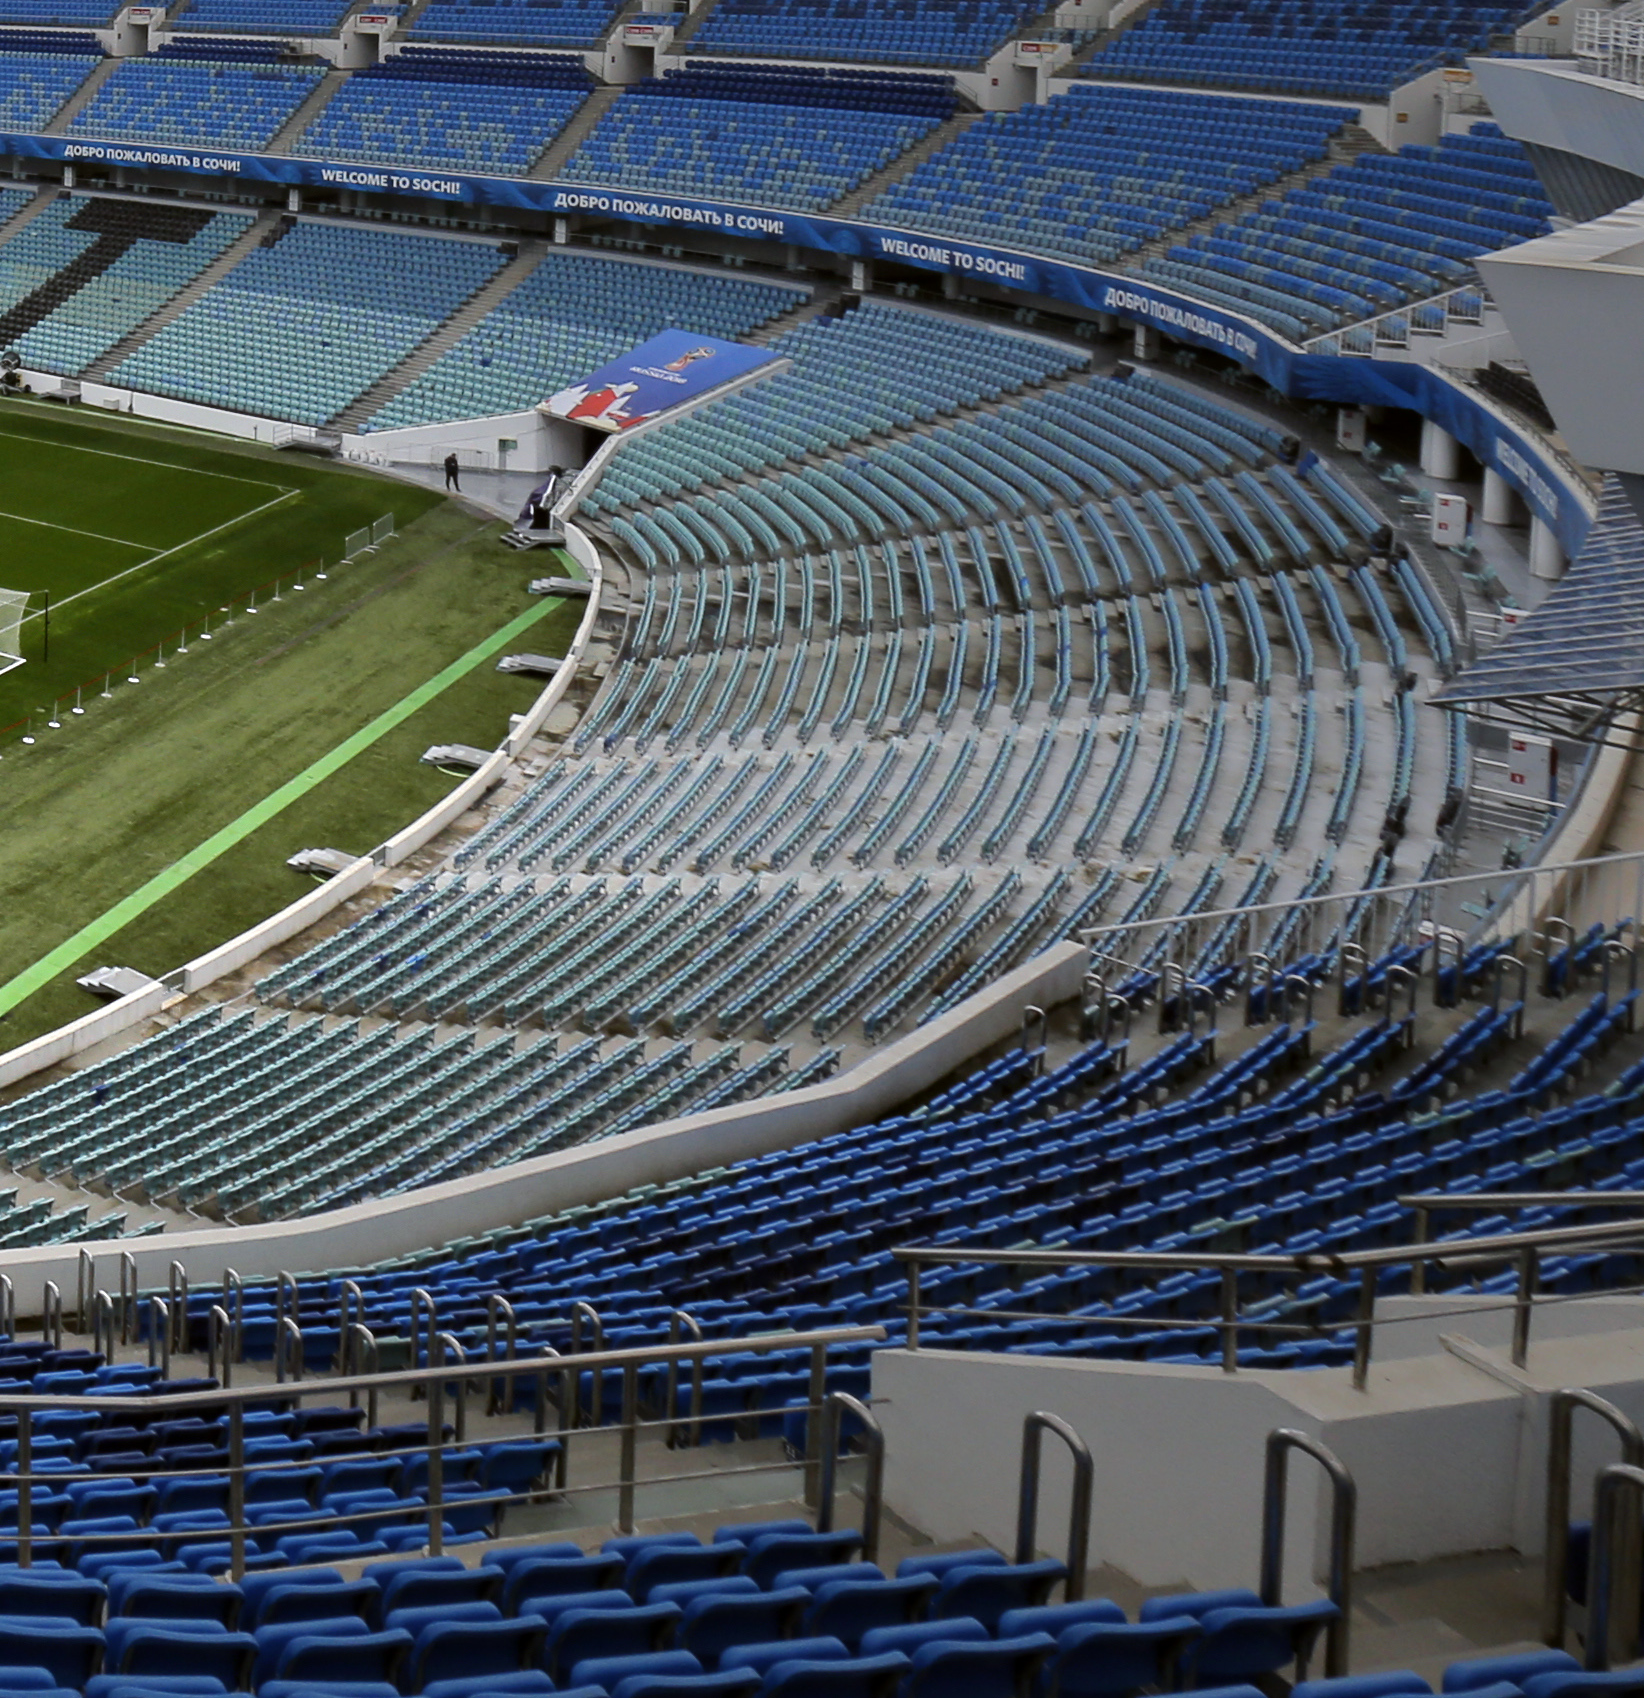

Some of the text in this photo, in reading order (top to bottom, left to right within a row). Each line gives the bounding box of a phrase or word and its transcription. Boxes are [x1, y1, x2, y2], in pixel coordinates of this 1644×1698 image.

[64, 145, 240, 171] ДОБРО ПОЖАЛОВАТЬ В СОЧИ!
[322, 169, 460, 194] WELCOME TO SOCHI!
[554, 193, 783, 234] ДОБРО ПОЖАЛОВАТЬ В СОЧИ!
[881, 238, 1024, 280] WELCOME TO SOCHI!
